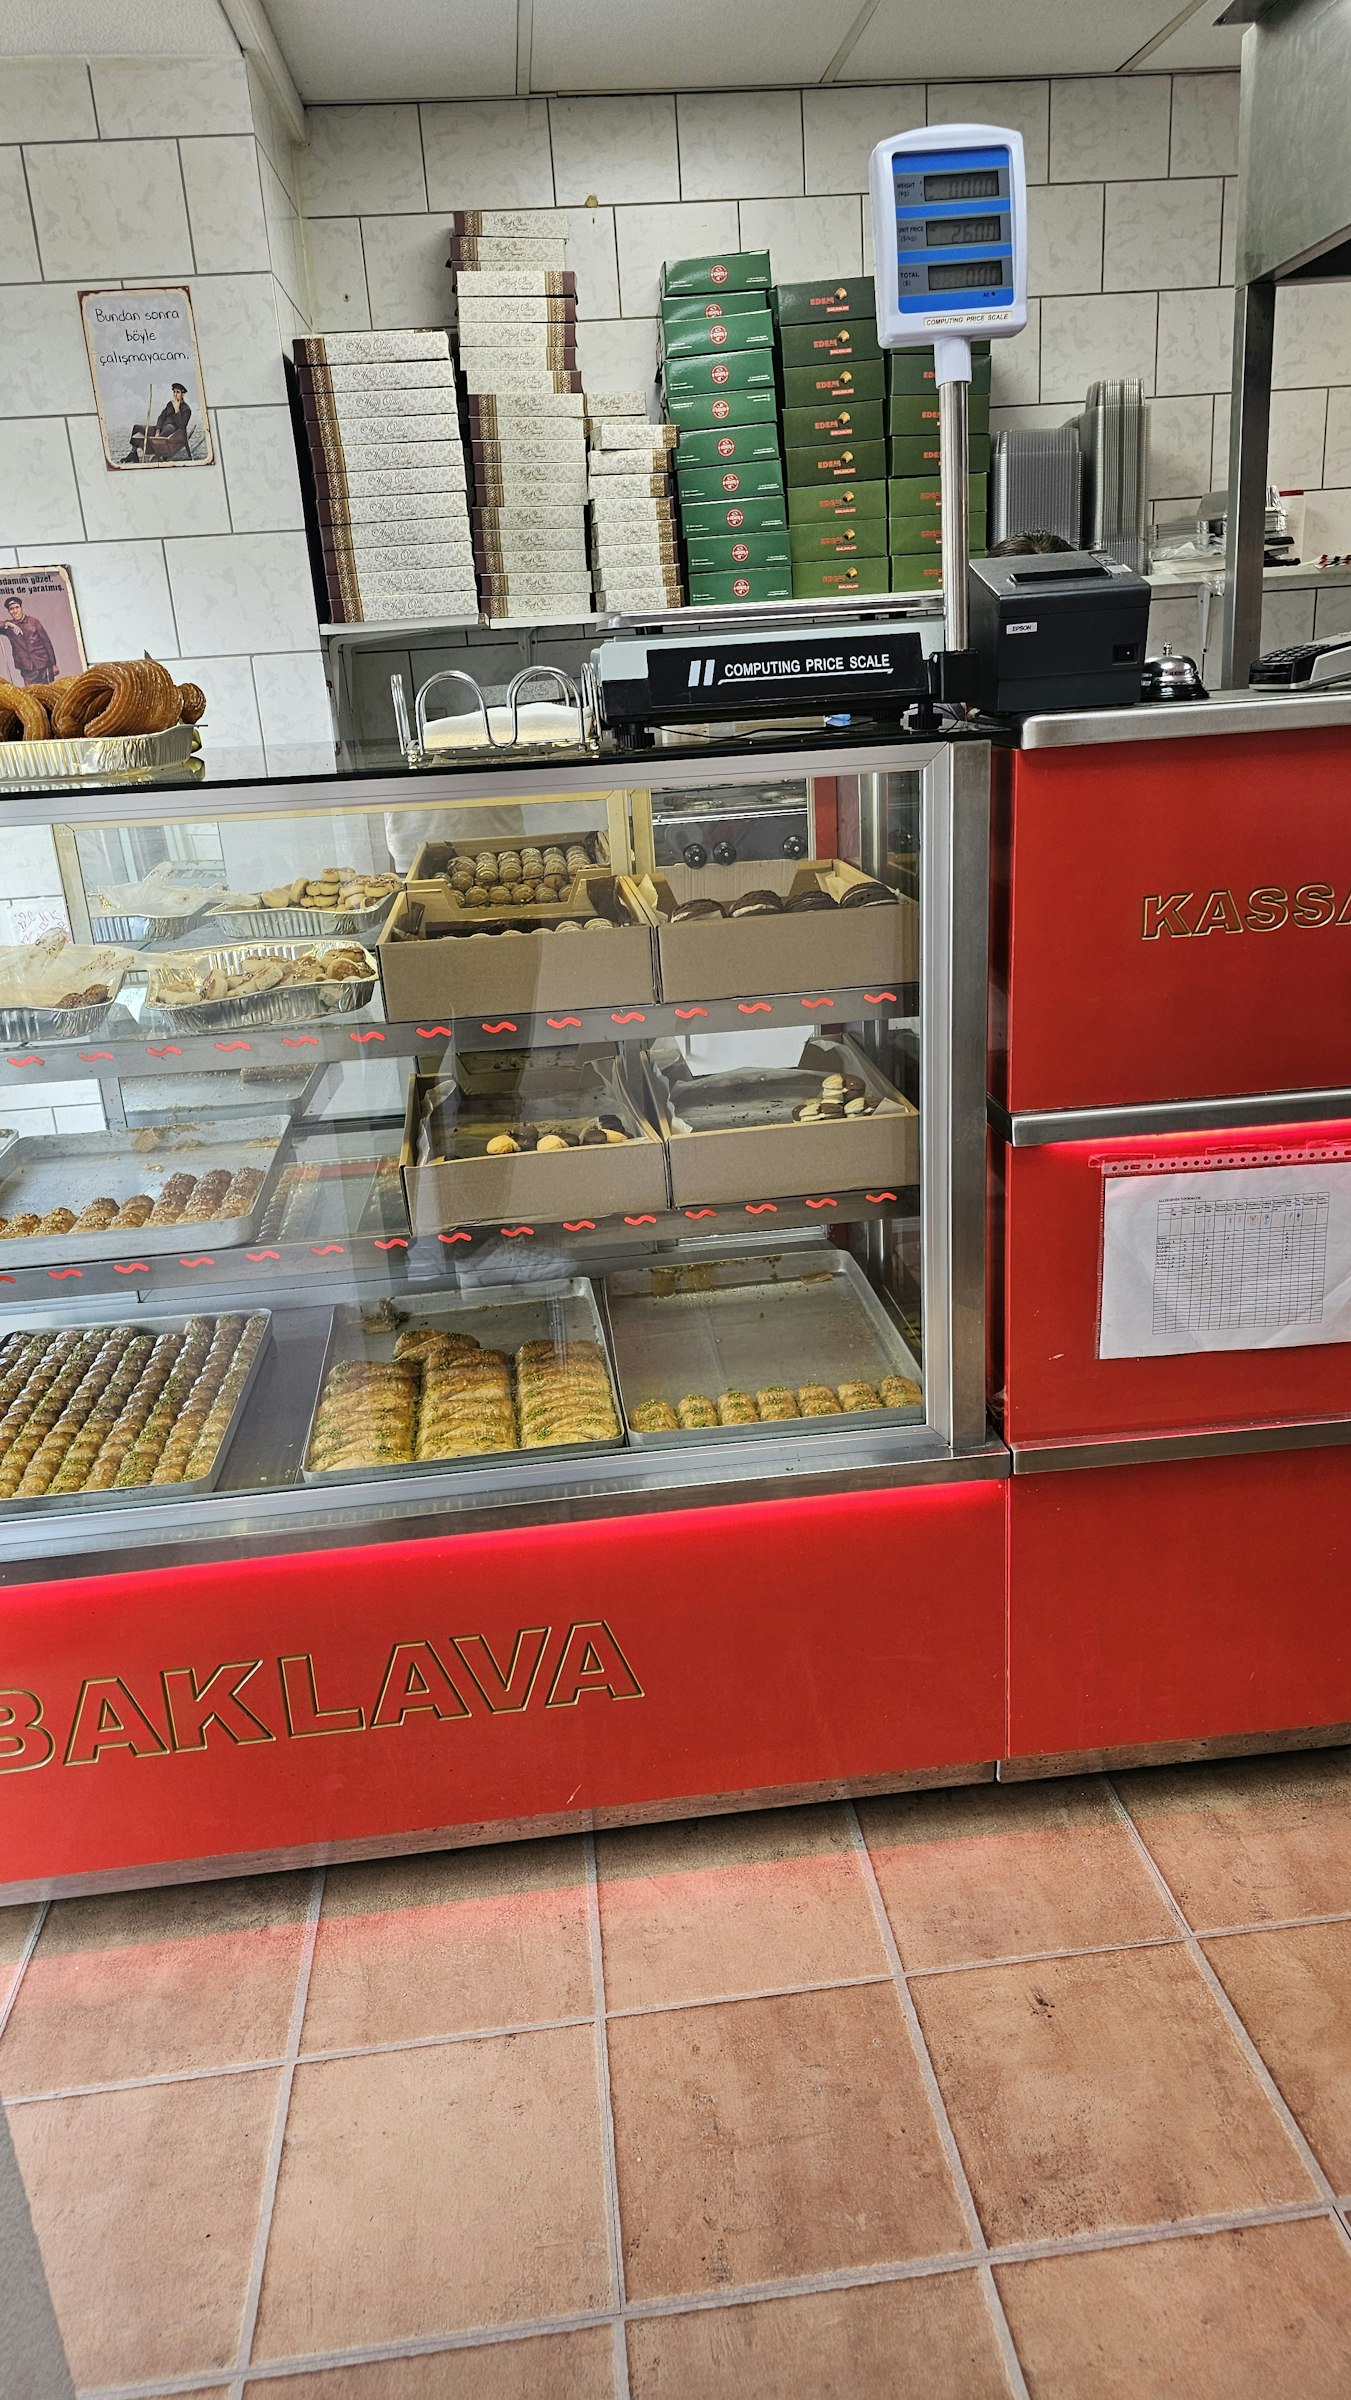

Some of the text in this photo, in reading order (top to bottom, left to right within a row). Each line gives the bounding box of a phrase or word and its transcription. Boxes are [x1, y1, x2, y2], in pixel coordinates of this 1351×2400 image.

[900, 271, 920, 279] TOTAL
[95, 308, 180, 323] Bundan sonra
[926, 317, 964, 326] COMPUTING
[988, 313, 1009, 321] SCALE
[125, 329, 157, 344] böyle
[99, 350, 190, 367] çalışmayacam.
[817, 459, 841, 469] EDEM
[30, 575, 54, 585] güzel,
[17, 586, 26, 594] de
[28, 584, 65, 594] yaratmış.
[724, 653, 891, 678] COMPUTING PRICE SCALE
[0, 1618, 645, 1775] BAKLAVA
